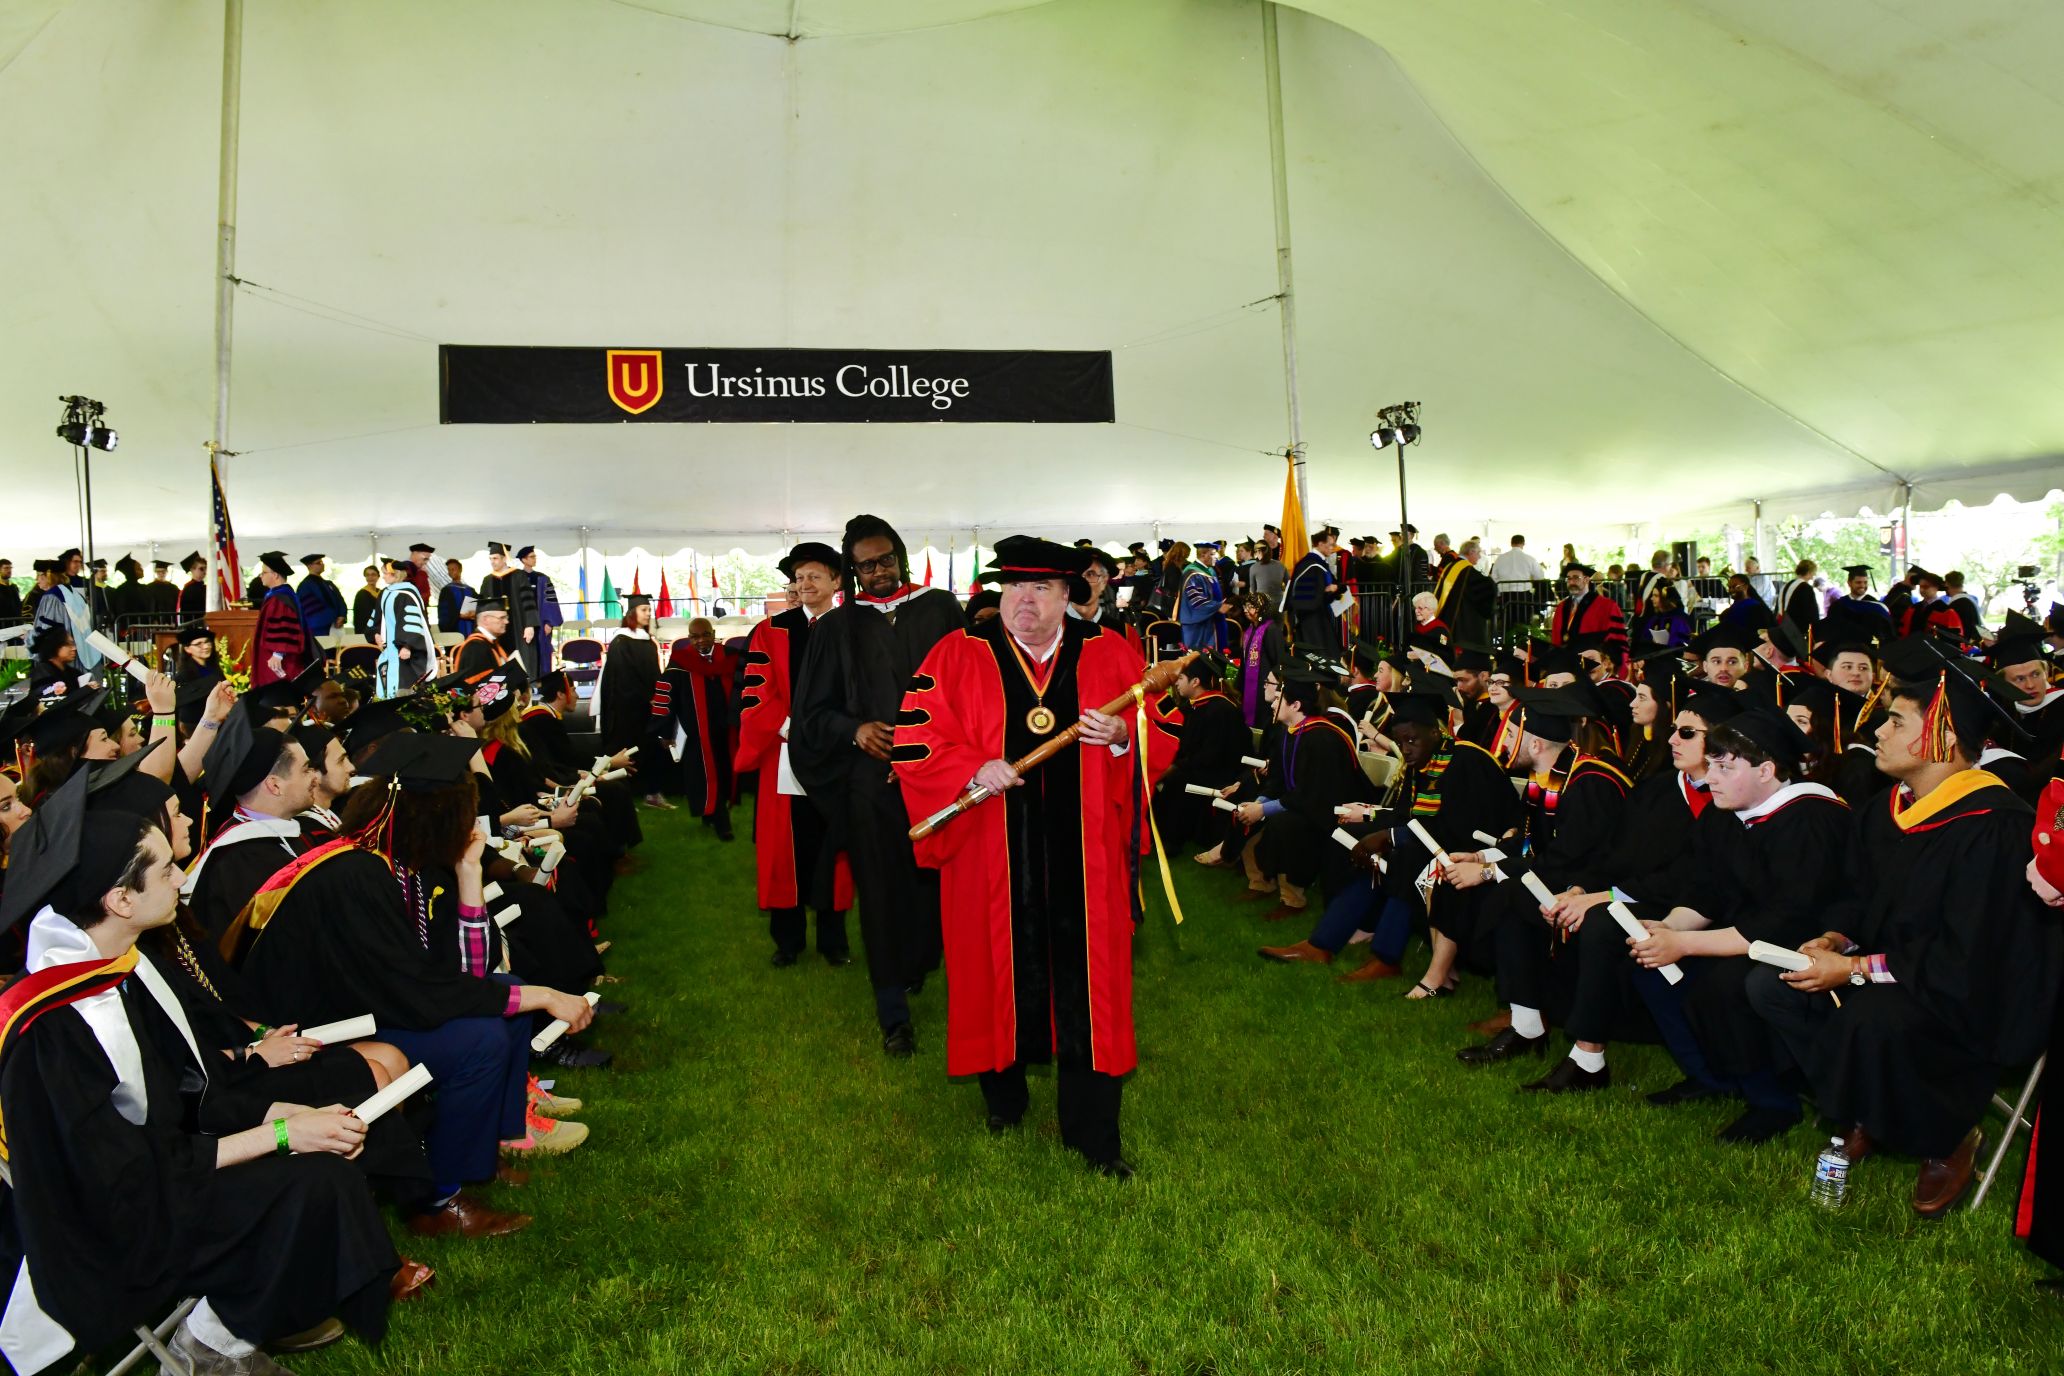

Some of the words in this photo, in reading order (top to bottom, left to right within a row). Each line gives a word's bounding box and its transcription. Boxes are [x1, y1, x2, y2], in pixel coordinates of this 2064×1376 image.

[622, 363, 648, 397] U
[685, 363, 826, 397] Ursinus
[835, 364, 970, 409] College
